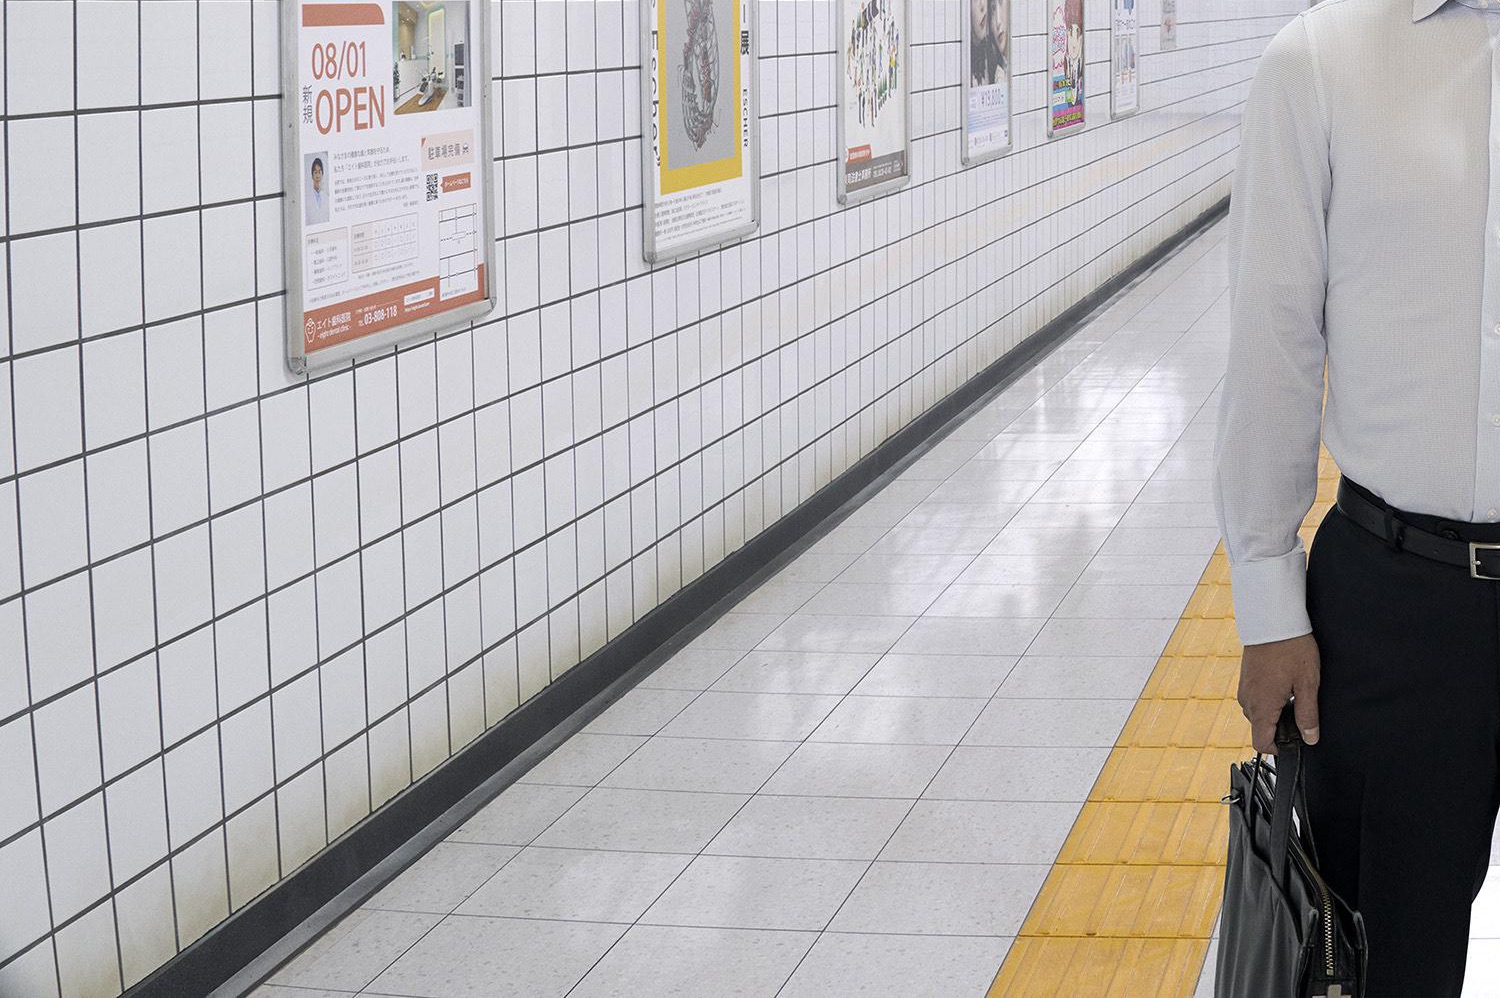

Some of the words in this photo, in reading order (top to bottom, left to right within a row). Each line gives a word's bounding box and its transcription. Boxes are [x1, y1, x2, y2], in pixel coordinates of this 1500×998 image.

[312, 40, 367, 81] 08/01
[302, 84, 314, 125] 新規
[315, 84, 386, 136] OPEN
